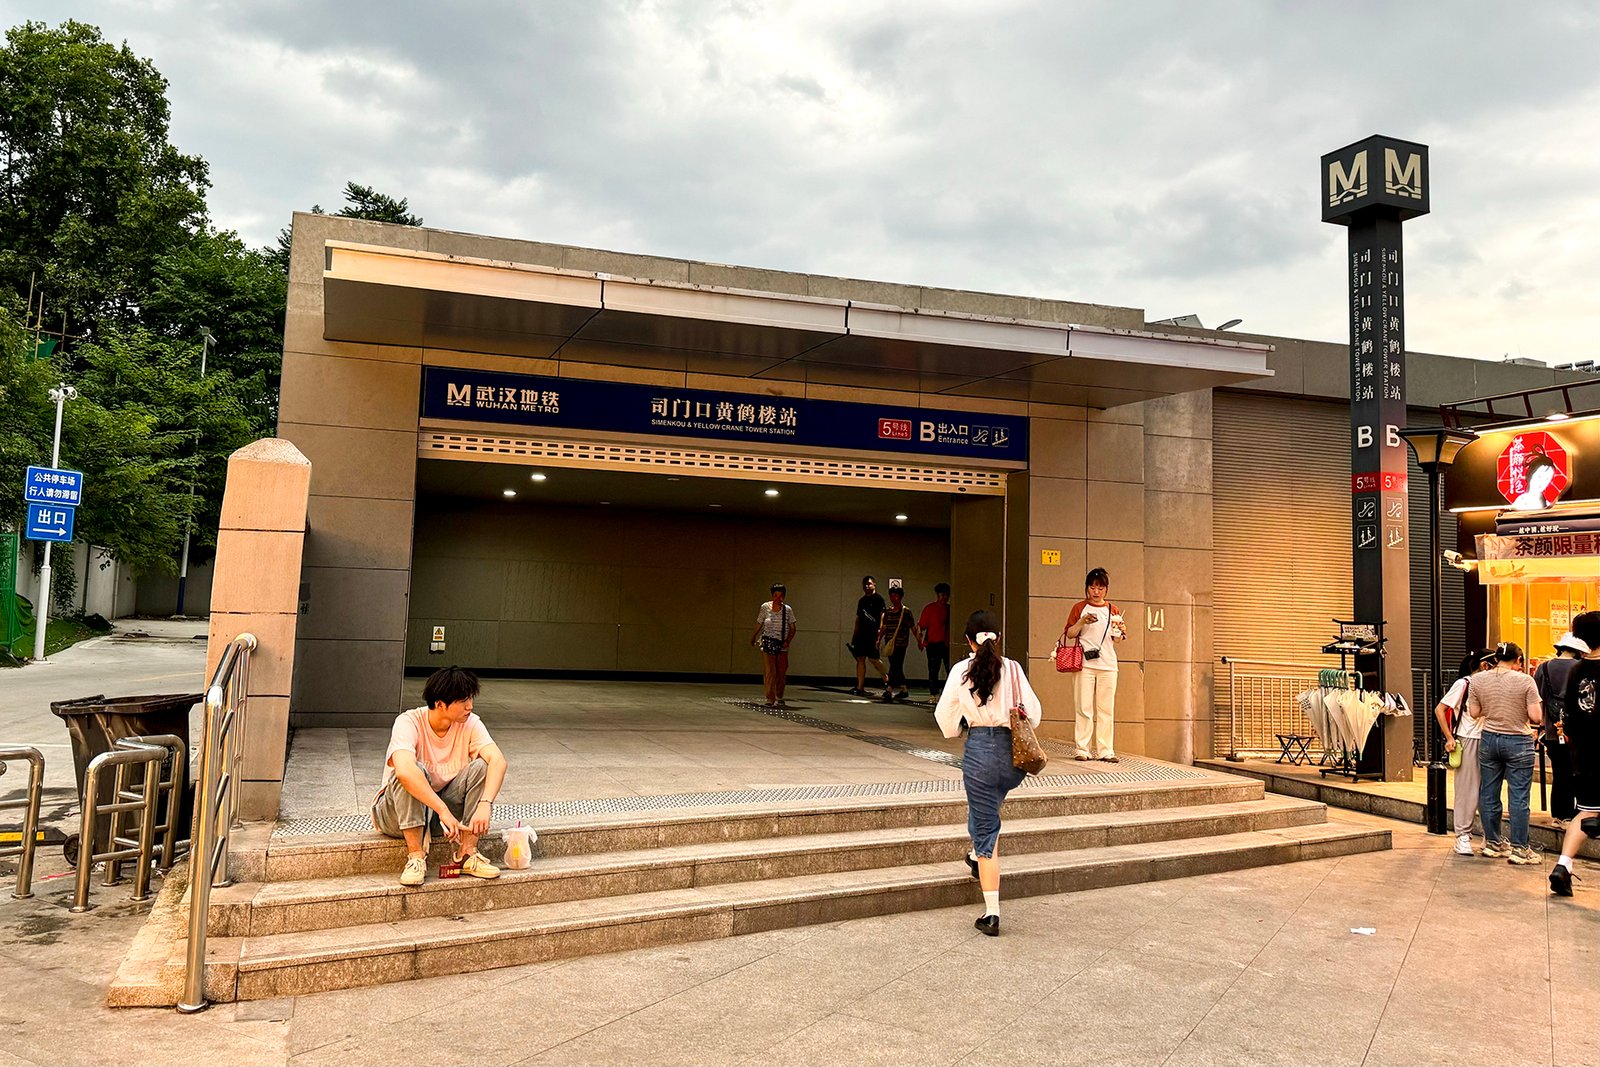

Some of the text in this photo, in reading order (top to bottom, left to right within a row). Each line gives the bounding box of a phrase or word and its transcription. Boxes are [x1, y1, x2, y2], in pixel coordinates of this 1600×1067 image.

[1361, 249, 1373, 399] 司门口黄鹤楼站
[1388, 249, 1400, 399] 司门口黄鹤楼站
[476, 386, 560, 407] 武汉地铁
[476, 401, 560, 414] WUHAN METRO
[651, 397, 798, 427] 司门口黄鹤楼站
[651, 419, 686, 428] SIMENKOU
[693, 422, 720, 430] YELLOW
[721, 424, 744, 432] CRANE
[920, 421, 936, 442] B
[938, 423, 968, 436] 出入口
[938, 436, 969, 445] Entrance
[1358, 426, 1373, 448] B
[1386, 425, 1401, 448] B
[34, 472, 76, 486] 公共停车场
[29, 485, 79, 501] 行人请勿滞留
[38, 509, 66, 525] 出口
